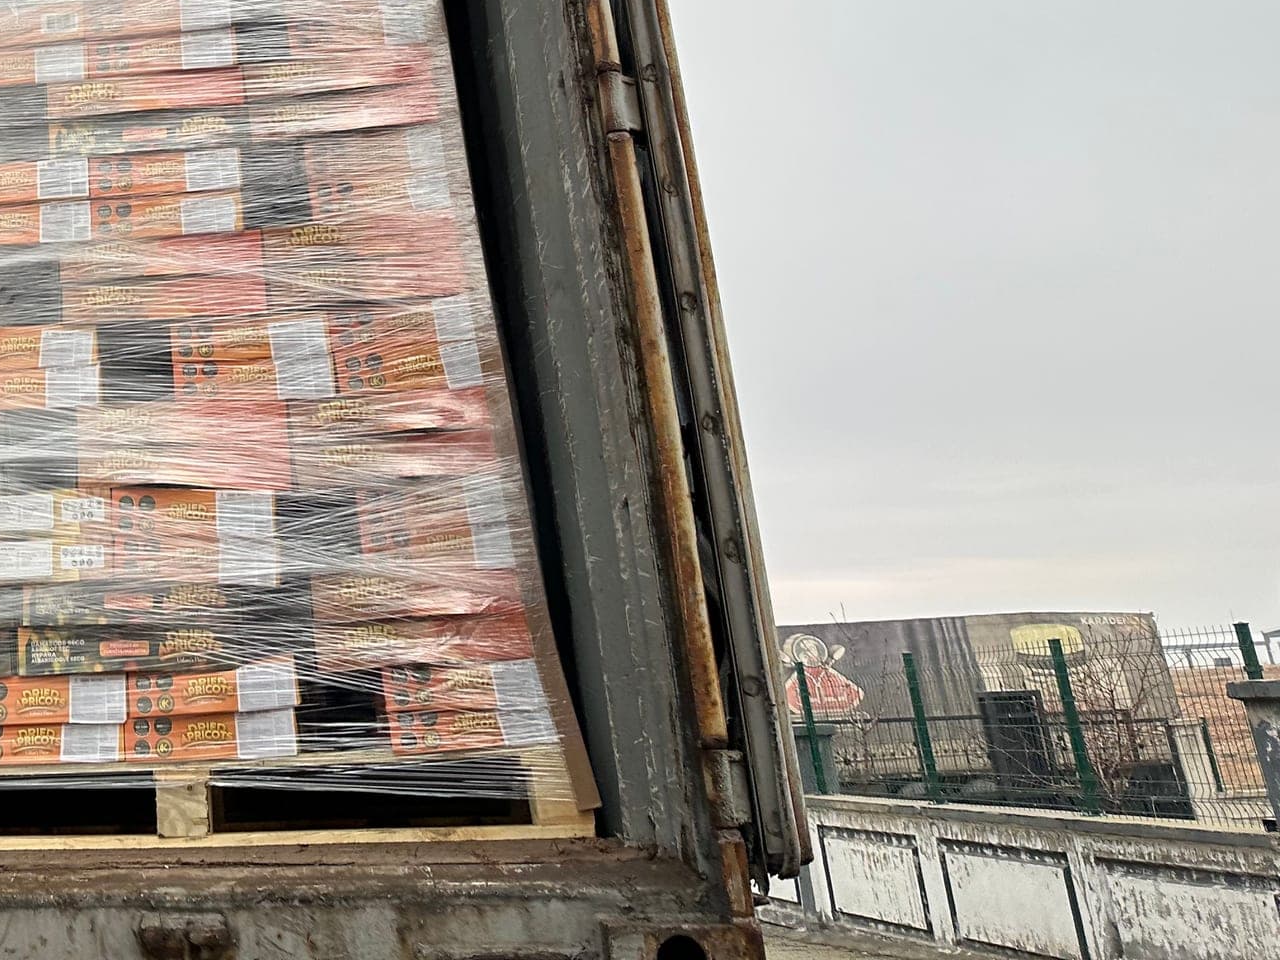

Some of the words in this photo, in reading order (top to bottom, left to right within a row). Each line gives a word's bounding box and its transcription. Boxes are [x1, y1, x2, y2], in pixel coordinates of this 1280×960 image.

[189, 678, 227, 687] DRIED
[22, 690, 58, 698] DRIED
[184, 686, 234, 697] APRICOTS
[16, 696, 64, 708] APRICOTS
[188, 723, 224, 732] DRIED
[18, 728, 55, 737] DRIED
[182, 730, 232, 741] APRICOTS
